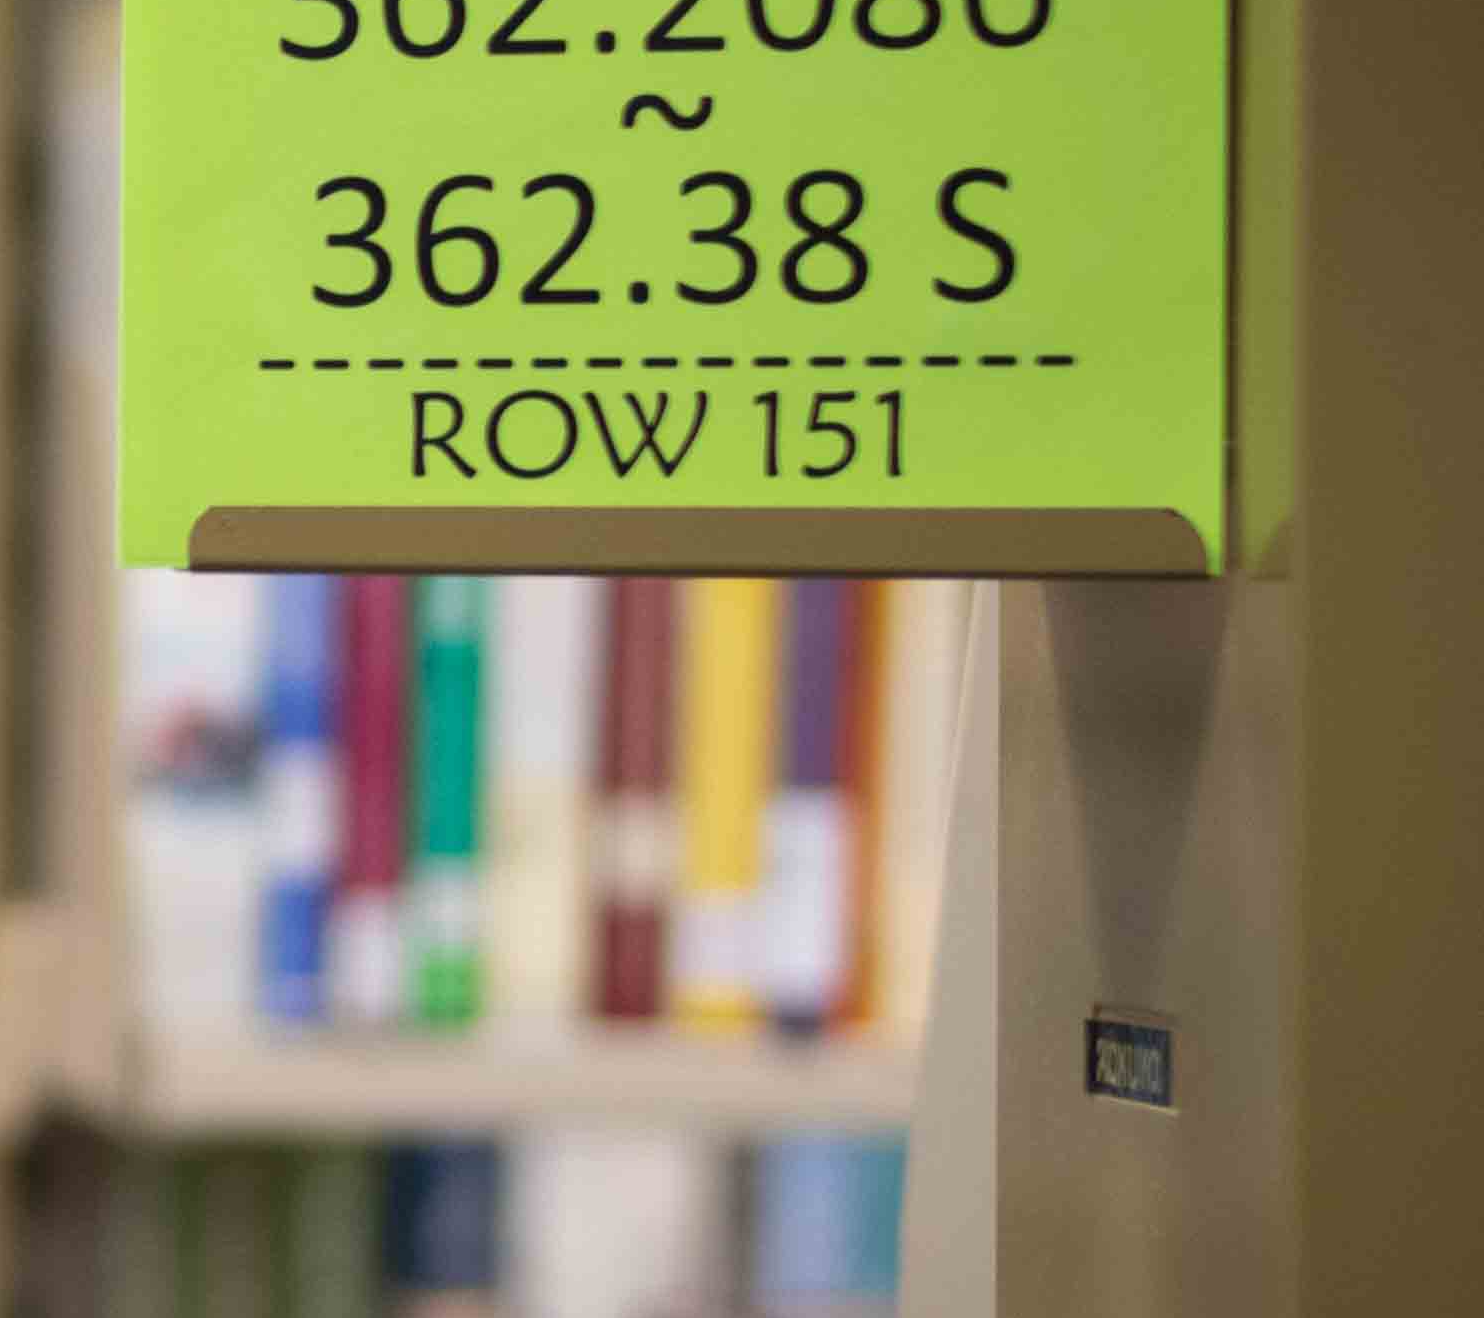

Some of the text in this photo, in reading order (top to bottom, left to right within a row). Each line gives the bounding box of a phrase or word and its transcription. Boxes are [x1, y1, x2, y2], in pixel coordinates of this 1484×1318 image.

[620, 93, 714, 132] ~
[311, 166, 1017, 309] 362.38 S
[411, 388, 904, 480] ROW 151
